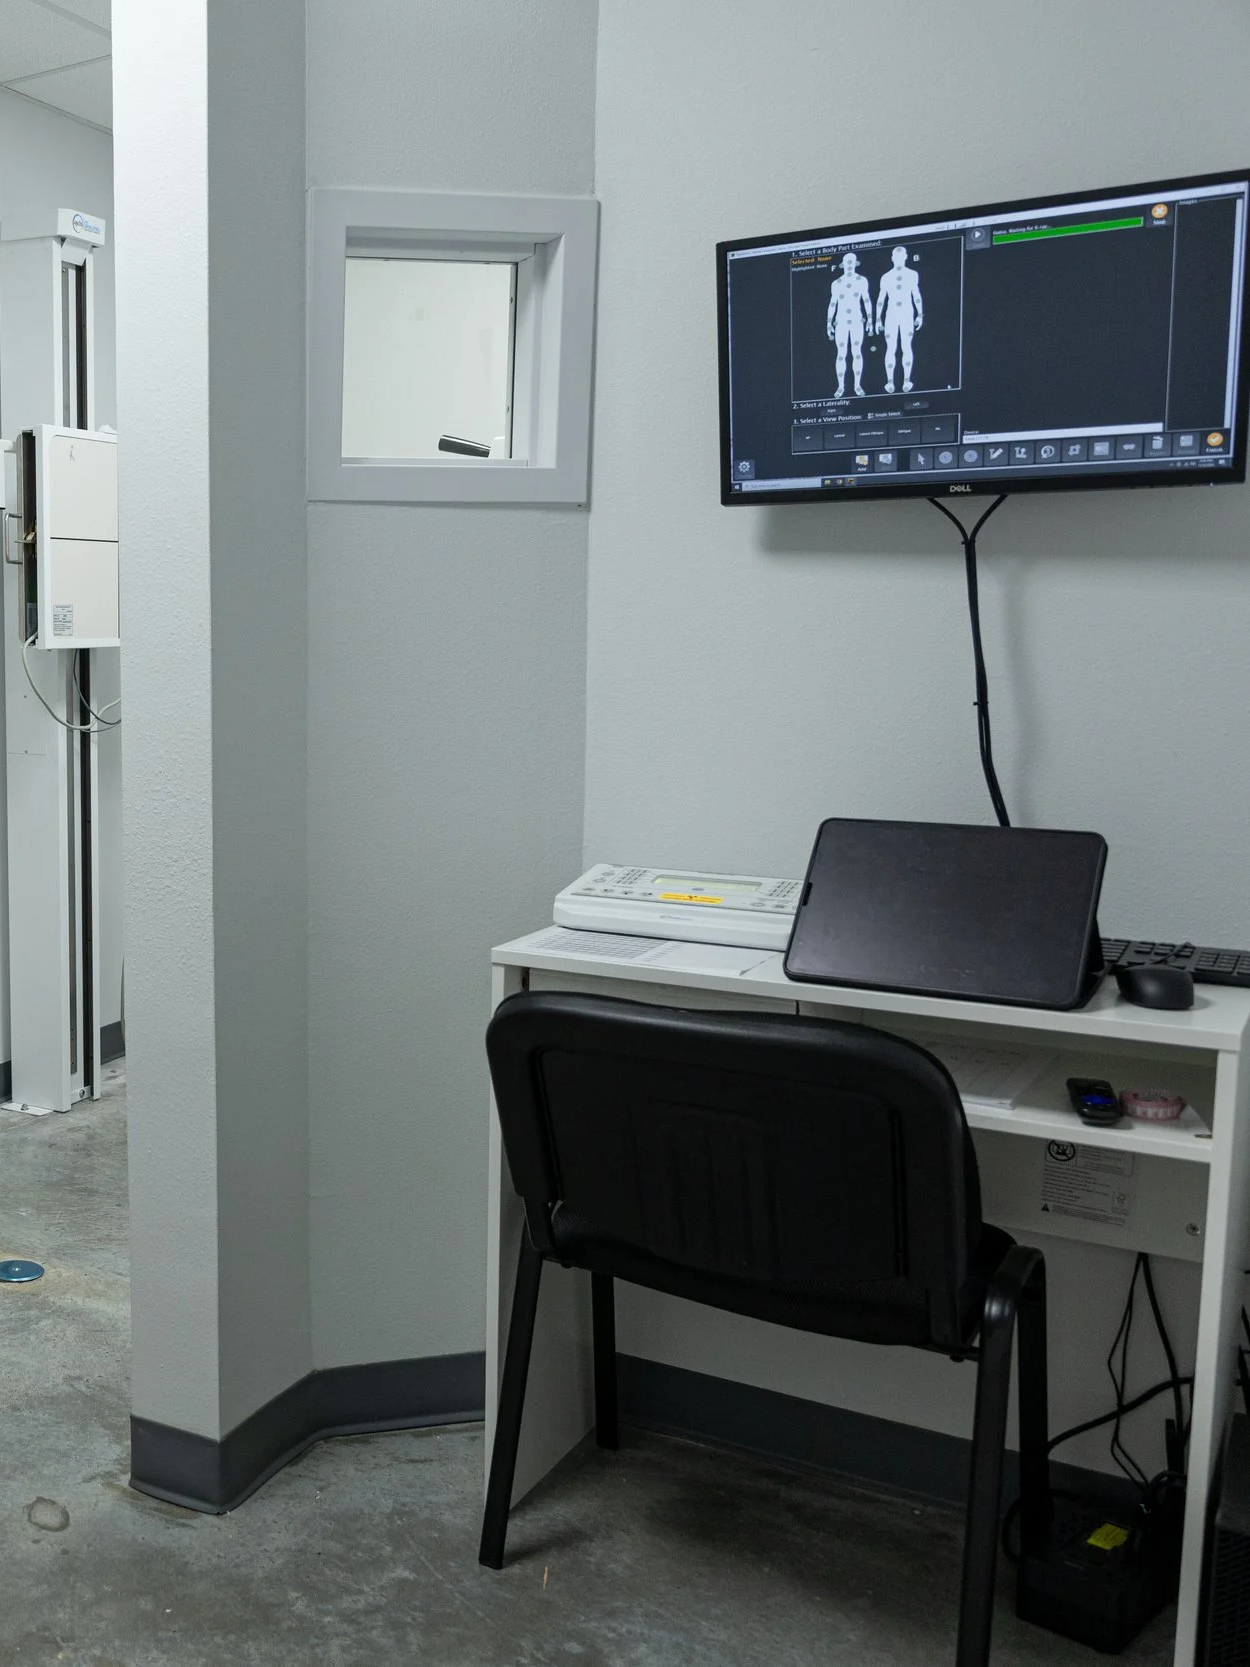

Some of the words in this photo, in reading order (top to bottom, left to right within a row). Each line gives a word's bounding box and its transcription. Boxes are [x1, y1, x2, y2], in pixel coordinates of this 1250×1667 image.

[798, 249, 816, 257] Select
[822, 246, 838, 254] Body
[837, 244, 850, 252] Part
[913, 254, 920, 262] B
[822, 415, 836, 423] View
[949, 484, 972, 493] DELL
